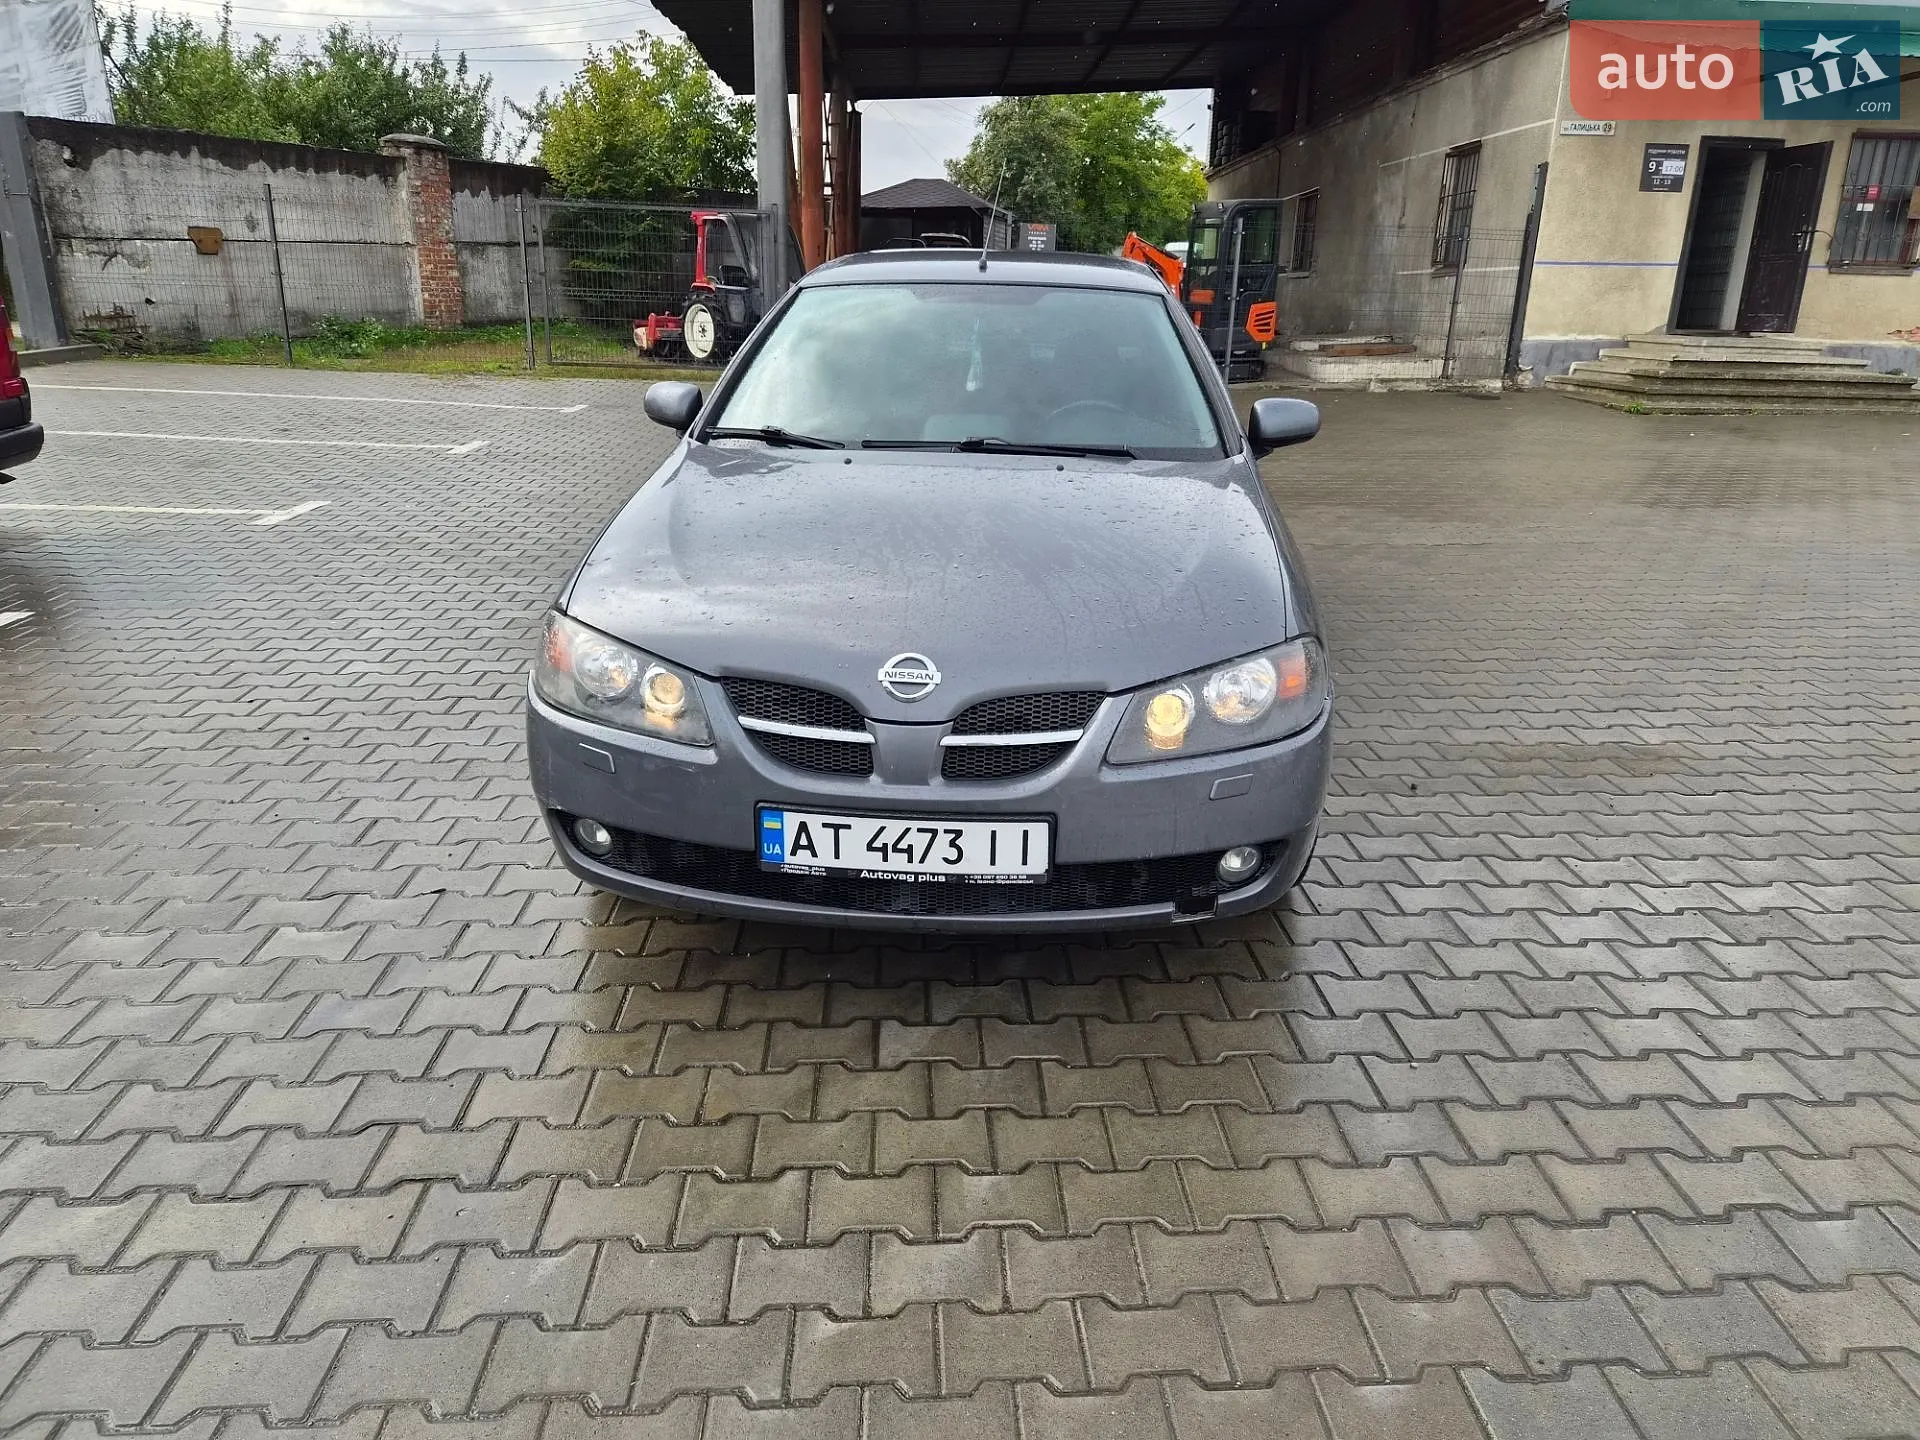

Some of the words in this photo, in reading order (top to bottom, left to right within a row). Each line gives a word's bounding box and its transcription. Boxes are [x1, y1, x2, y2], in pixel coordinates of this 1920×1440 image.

[1569, 122, 1600, 132] ГАЛИЦЬКА
[1648, 161, 1656, 173] 9
[884, 670, 935, 681] NISSAN
[789, 820, 852, 860] AT
[866, 825, 964, 866] 4473
[764, 843, 782, 856] UA
[860, 869, 915, 882] Autovag
[918, 873, 946, 883] plus
